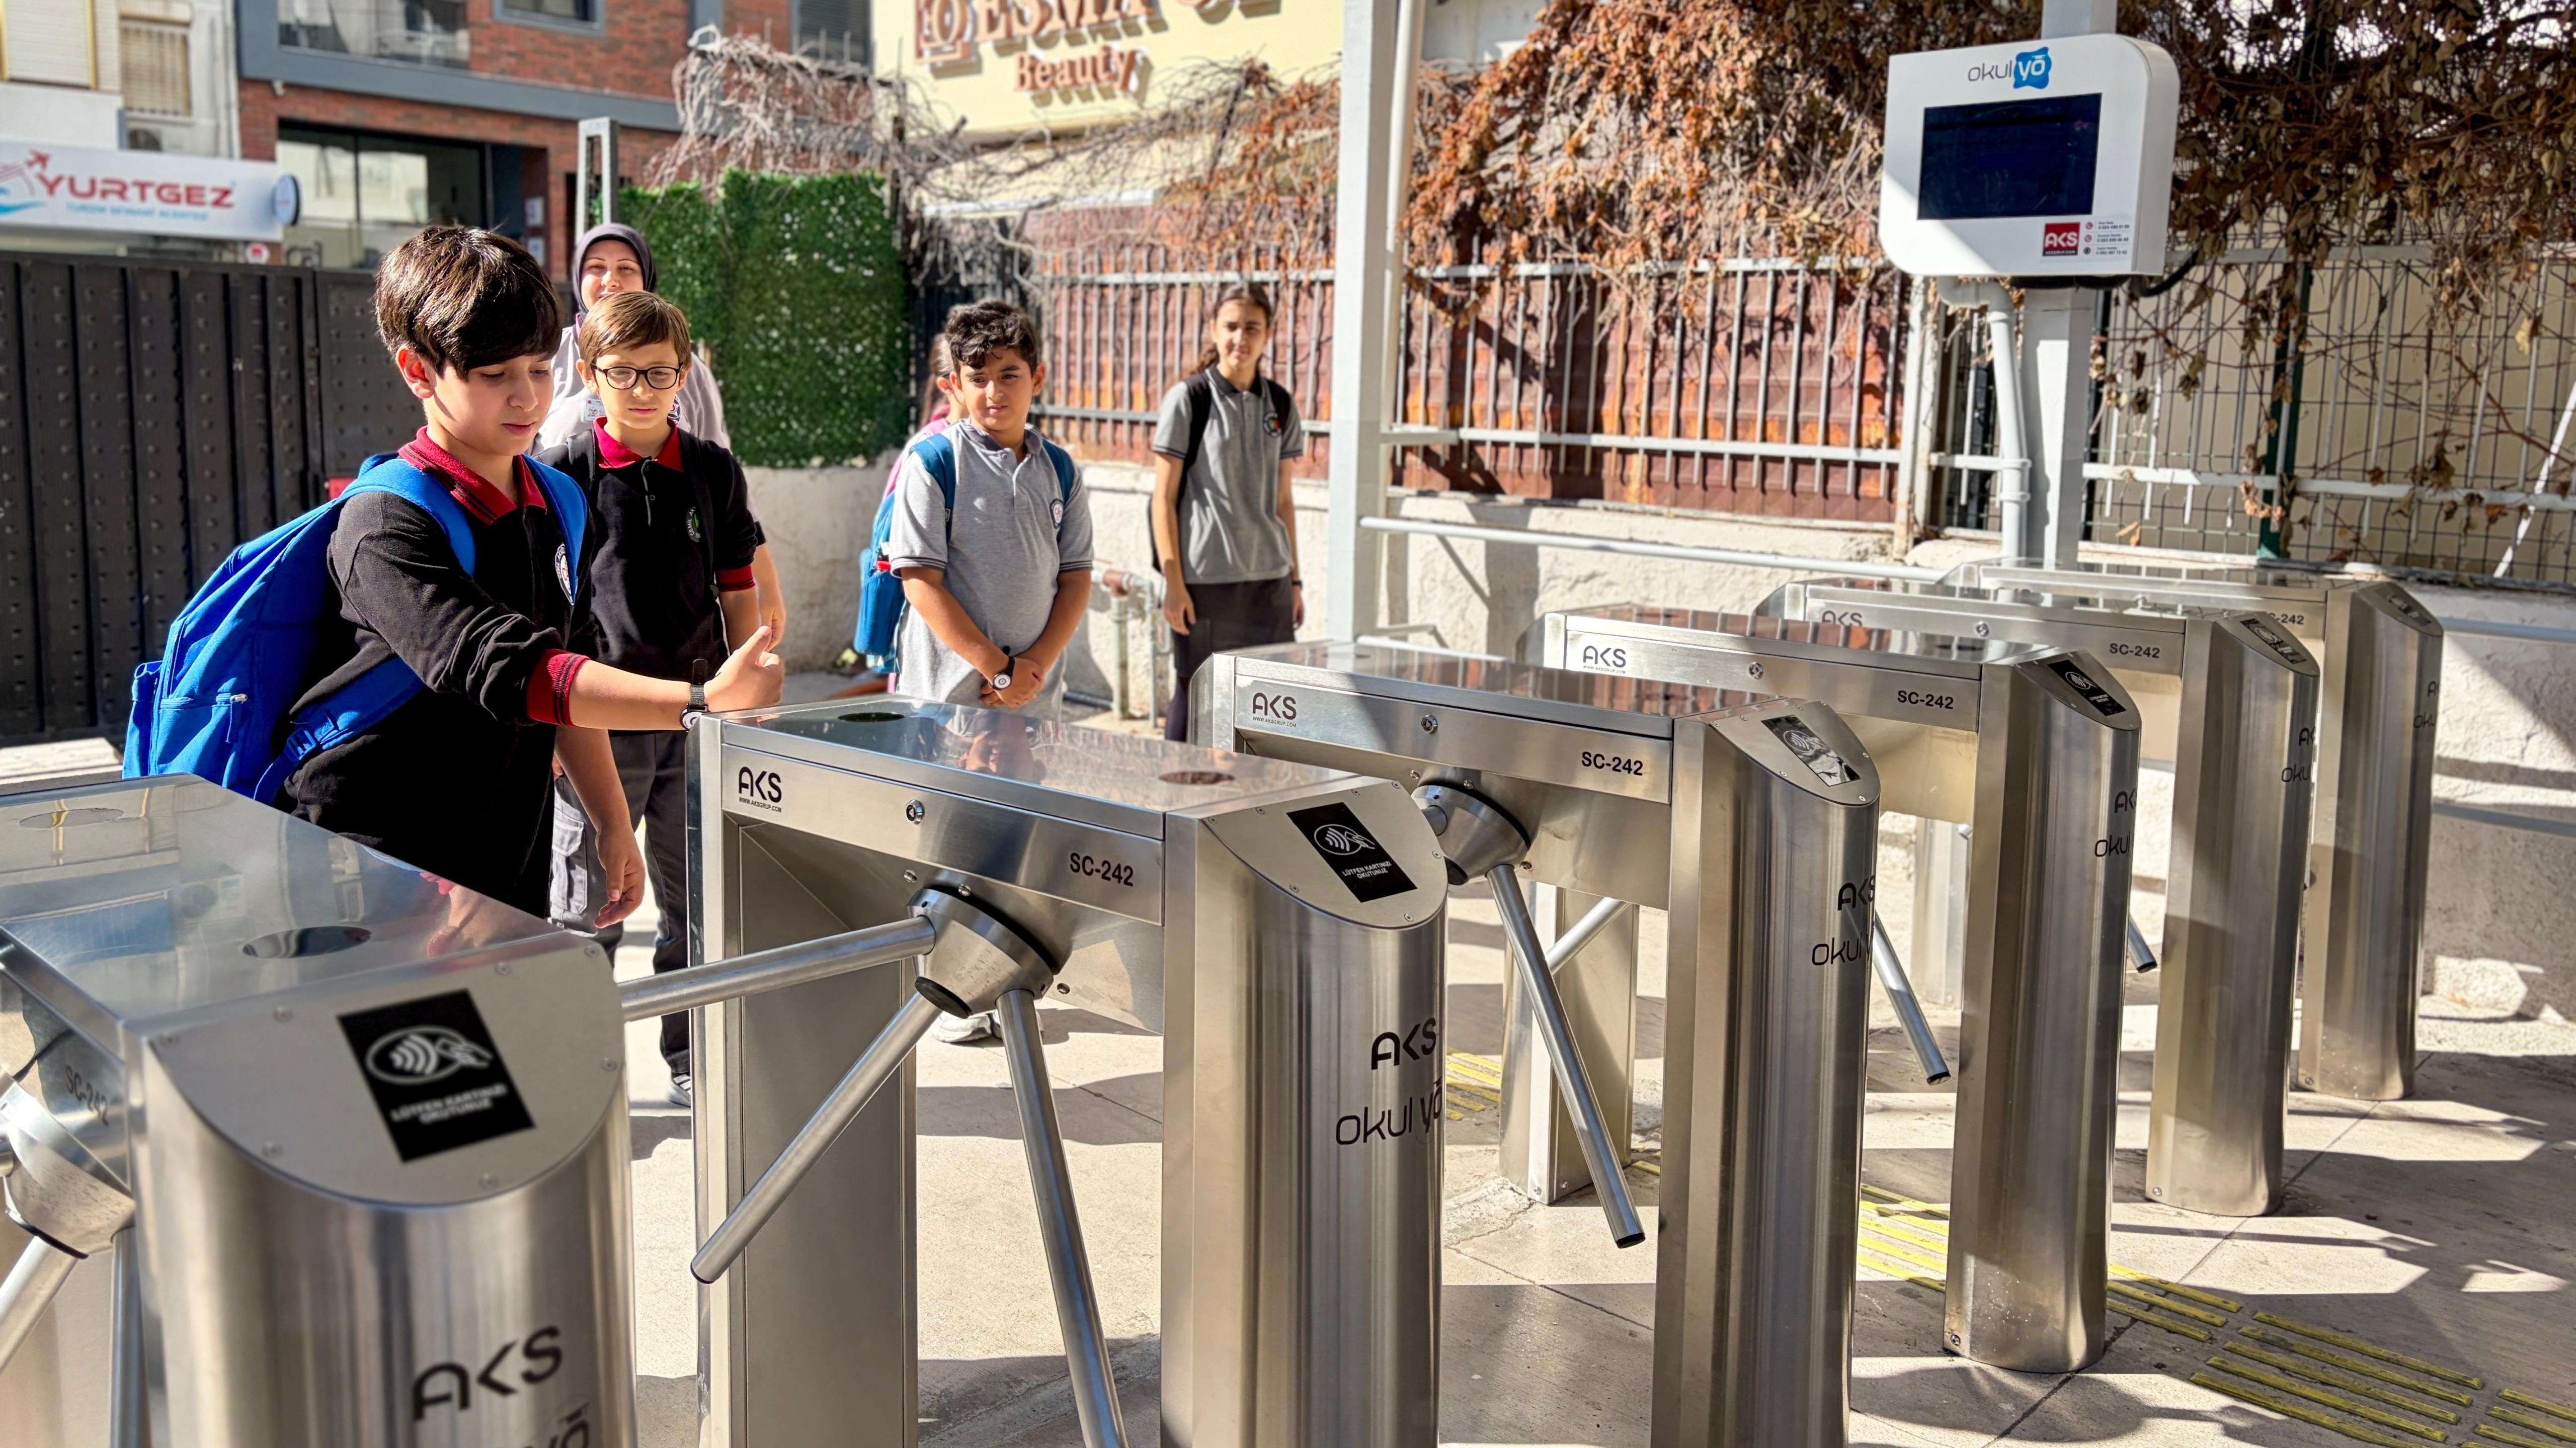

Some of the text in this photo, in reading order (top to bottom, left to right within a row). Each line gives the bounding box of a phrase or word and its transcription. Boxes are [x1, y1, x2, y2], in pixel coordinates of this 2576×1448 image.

[1014, 47, 1139, 92] Beauty
[36, 173, 233, 209] YURTGEZ
[2045, 232, 2077, 247] AKS
[1822, 610, 1863, 627] AKS
[2270, 613, 2304, 625] -242
[1583, 645, 1626, 667] AKS
[2110, 643, 2160, 658] SC-242
[1252, 692, 1297, 720] AKS
[1898, 690, 1954, 709] SC-242
[2298, 725, 2315, 746] AK
[1581, 751, 1643, 776] SC-242
[739, 766, 782, 803] AKS
[2114, 788, 2137, 813] AK
[1070, 853, 1134, 887] SC-242
[1837, 875, 1876, 910] AKS
[1812, 932, 1862, 966] okul
[1371, 1017, 1436, 1070] AKS
[65, 1064, 109, 1127] SC-242
[1336, 1097, 1413, 1145] okul
[413, 1325, 562, 1422] AKS
